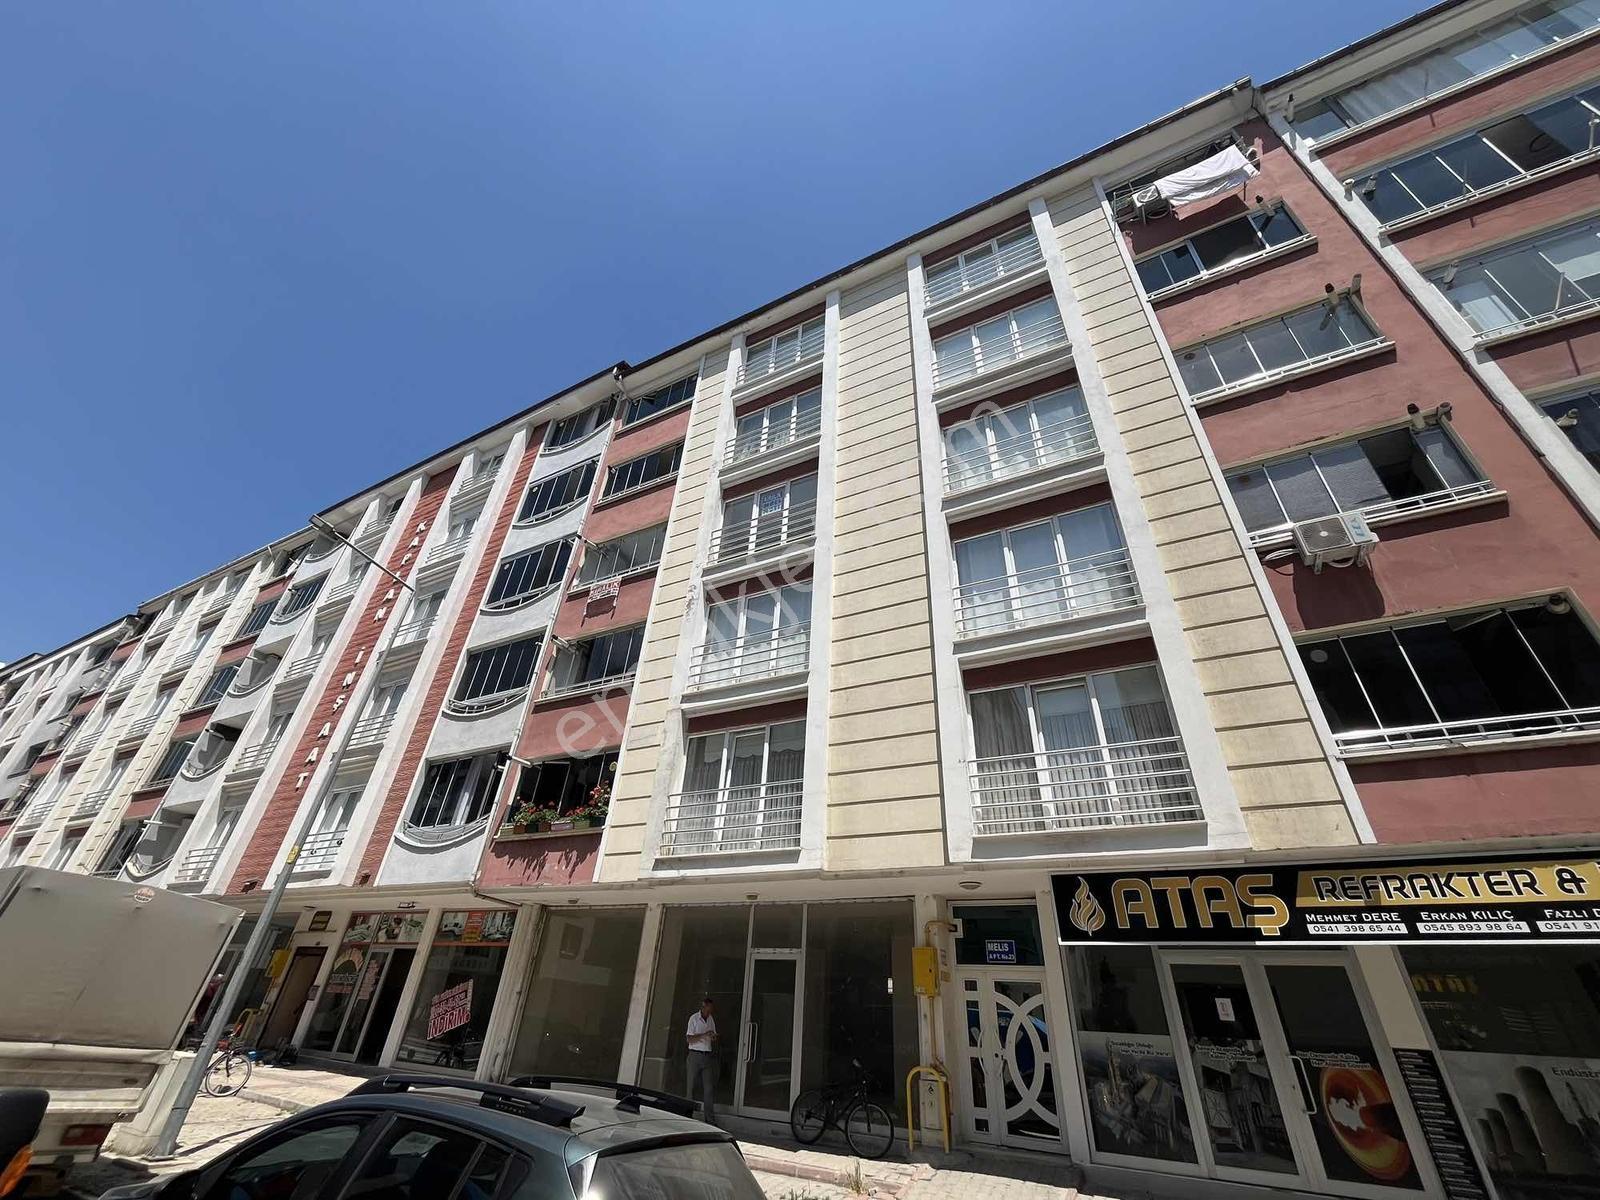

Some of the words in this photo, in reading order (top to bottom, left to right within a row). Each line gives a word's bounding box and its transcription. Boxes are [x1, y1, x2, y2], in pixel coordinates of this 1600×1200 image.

[374, 520, 427, 623] KAPLAN
[295, 646, 366, 791] İNŞAAT
[1312, 866, 1547, 902] REFRAKTER
[1554, 866, 1588, 896] &
[1111, 873, 1290, 936] ATAŞ
[1305, 913, 1358, 923] MEHMET
[1361, 912, 1402, 922] DERE
[1420, 911, 1466, 921] ERKAN
[1471, 910, 1514, 923] KILIÇ
[1544, 909, 1589, 920] FAZLI
[1313, 925, 1341, 933] 0541
[1345, 925, 1366, 933] 398
[1369, 924, 1384, 932] 65
[1387, 924, 1402, 932] 44
[1423, 923, 1453, 932] 0545
[1457, 923, 1482, 932] 893
[1485, 923, 1502, 932] 98
[1506, 923, 1523, 932] 64
[1545, 922, 1578, 931] 0541
